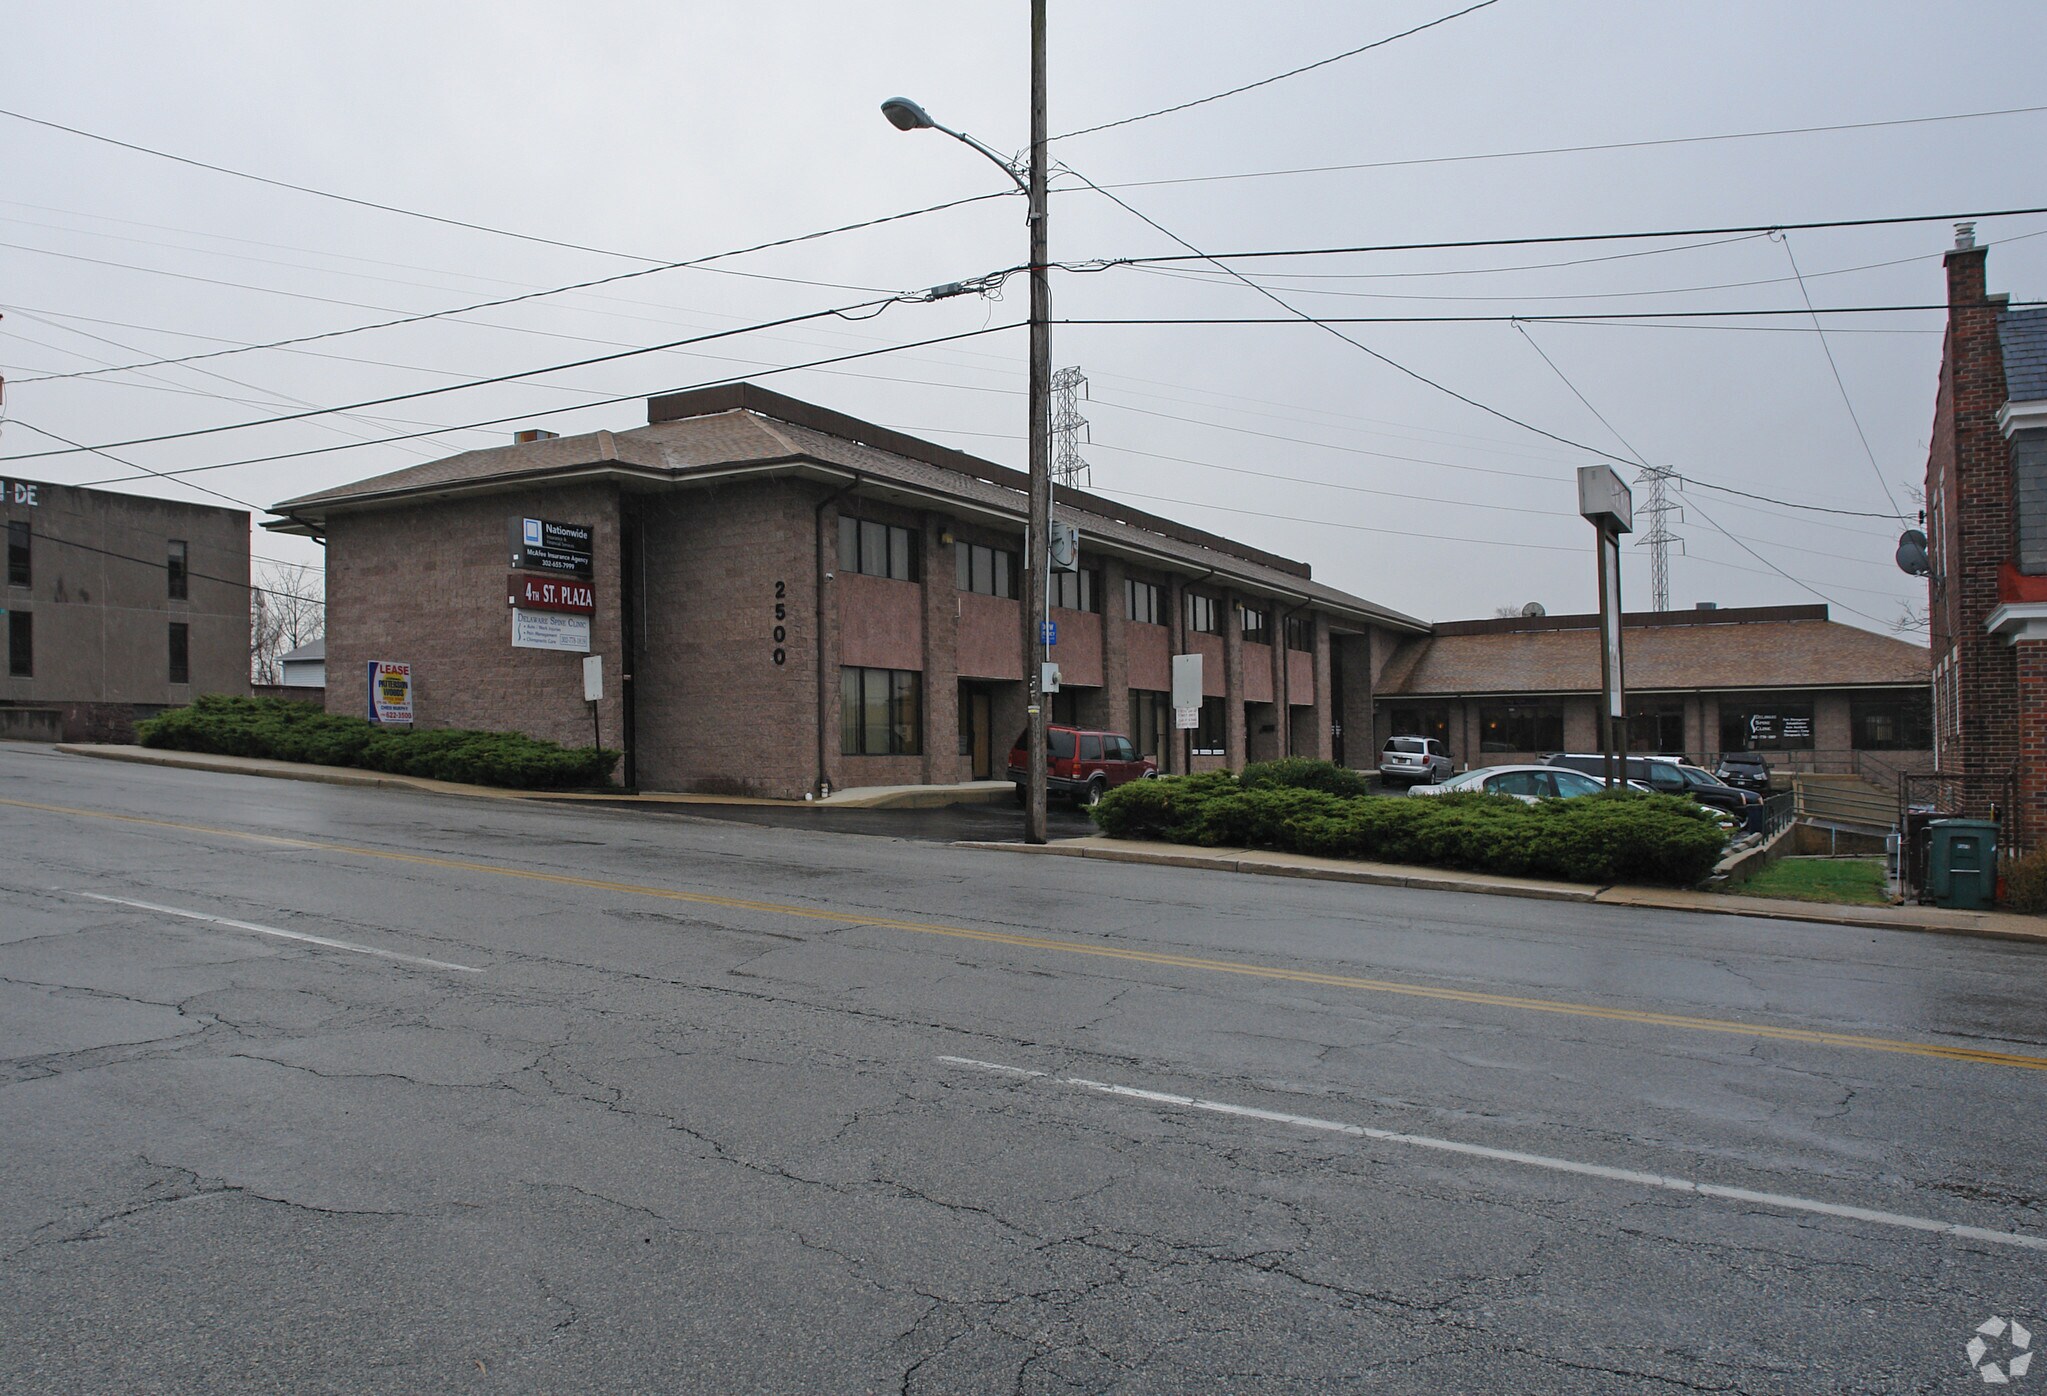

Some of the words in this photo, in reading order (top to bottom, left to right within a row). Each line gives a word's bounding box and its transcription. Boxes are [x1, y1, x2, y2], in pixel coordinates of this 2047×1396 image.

[545, 523, 588, 540] Nationwide
[527, 548, 547, 557] McAfee
[547, 552, 570, 560] Insurance
[571, 555, 589, 565] Agency
[543, 584, 558, 603] ST.
[561, 586, 593, 607] PLAZA
[517, 613, 549, 625] DELAWARE
[550, 616, 567, 626] SPINE
[568, 618, 587, 629] CLINIC
[773, 581, 786, 665] 2500
[380, 664, 409, 675] LEASE
